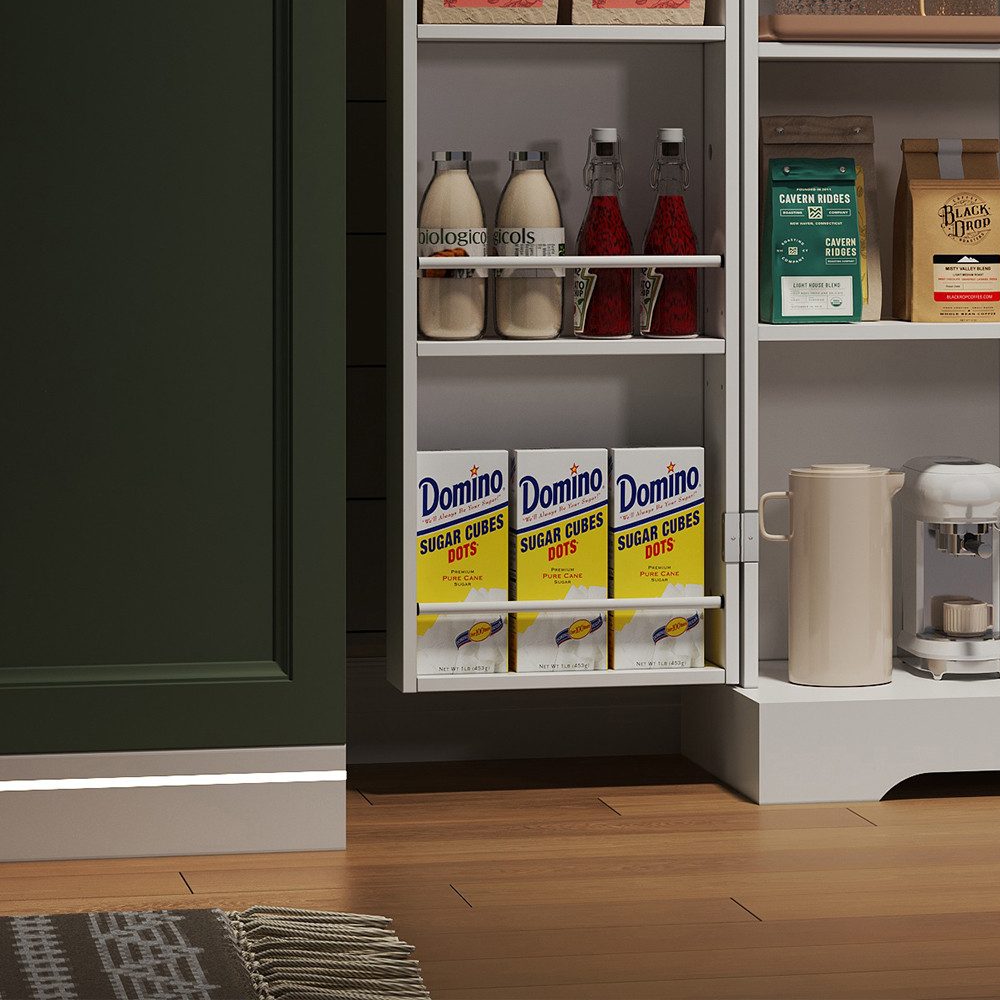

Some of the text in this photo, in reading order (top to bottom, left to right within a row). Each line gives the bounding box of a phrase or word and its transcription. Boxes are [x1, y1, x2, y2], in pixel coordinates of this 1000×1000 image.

[779, 193, 851, 204] CAVERN RIDGES
[938, 204, 990, 227] BLACK
[948, 217, 991, 237] DROP
[825, 237, 857, 247] CAVERN
[825, 247, 857, 257] RIDGES
[418, 469, 503, 518] Domino
[519, 467, 603, 516] Domino
[616, 466, 699, 514] Domino
[420, 513, 504, 556] SUGAR CUBES
[520, 511, 604, 554] SUGAR CUBES
[617, 509, 701, 551] SUGAR CUBES
[447, 541, 477, 564] DOTS
[547, 539, 577, 562] DOTS
[644, 537, 674, 560] DOTS
